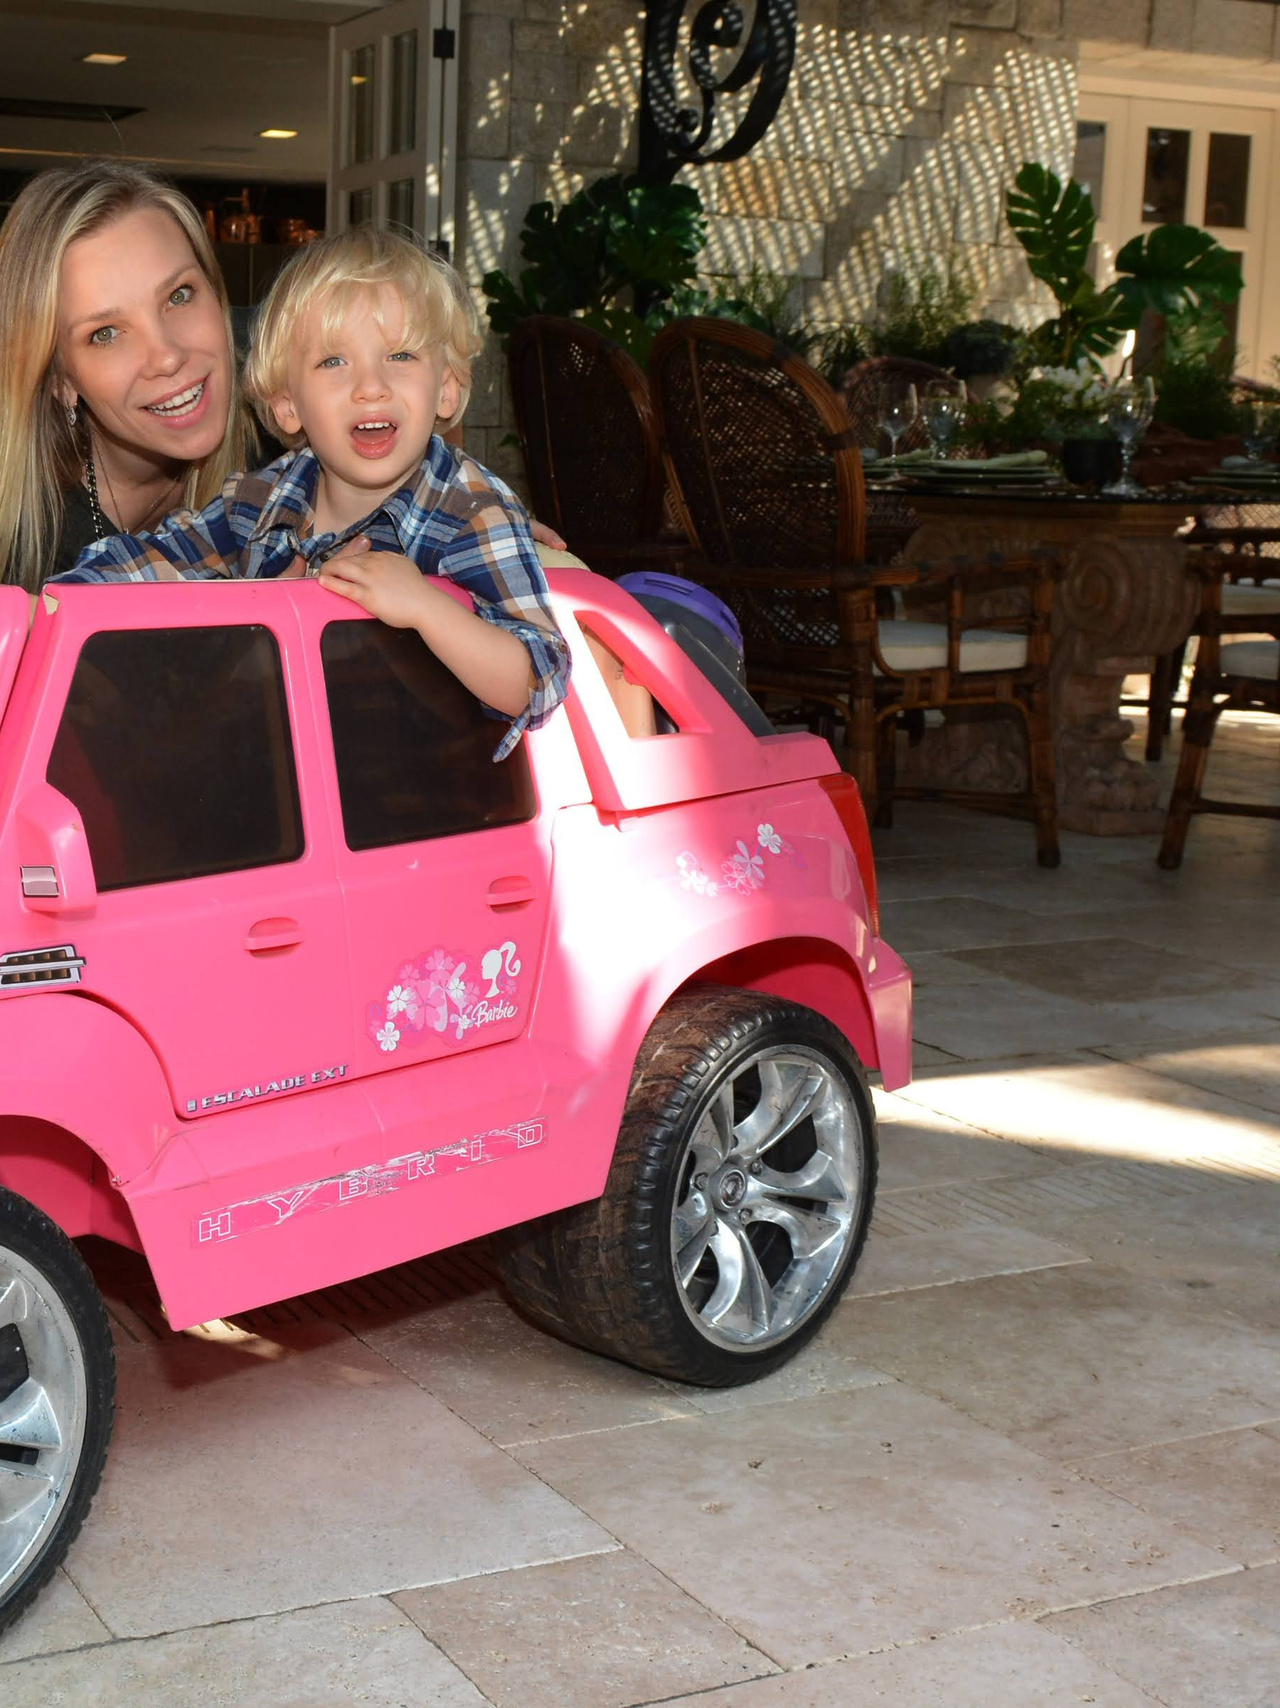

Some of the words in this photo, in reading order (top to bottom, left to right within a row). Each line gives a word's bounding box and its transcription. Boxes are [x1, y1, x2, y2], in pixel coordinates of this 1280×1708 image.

[471, 1000, 518, 1028] Barbie
[201, 1075, 306, 1108] ESCALADE
[311, 1064, 348, 1083] EXT
[199, 1124, 544, 1242] HYBRID
